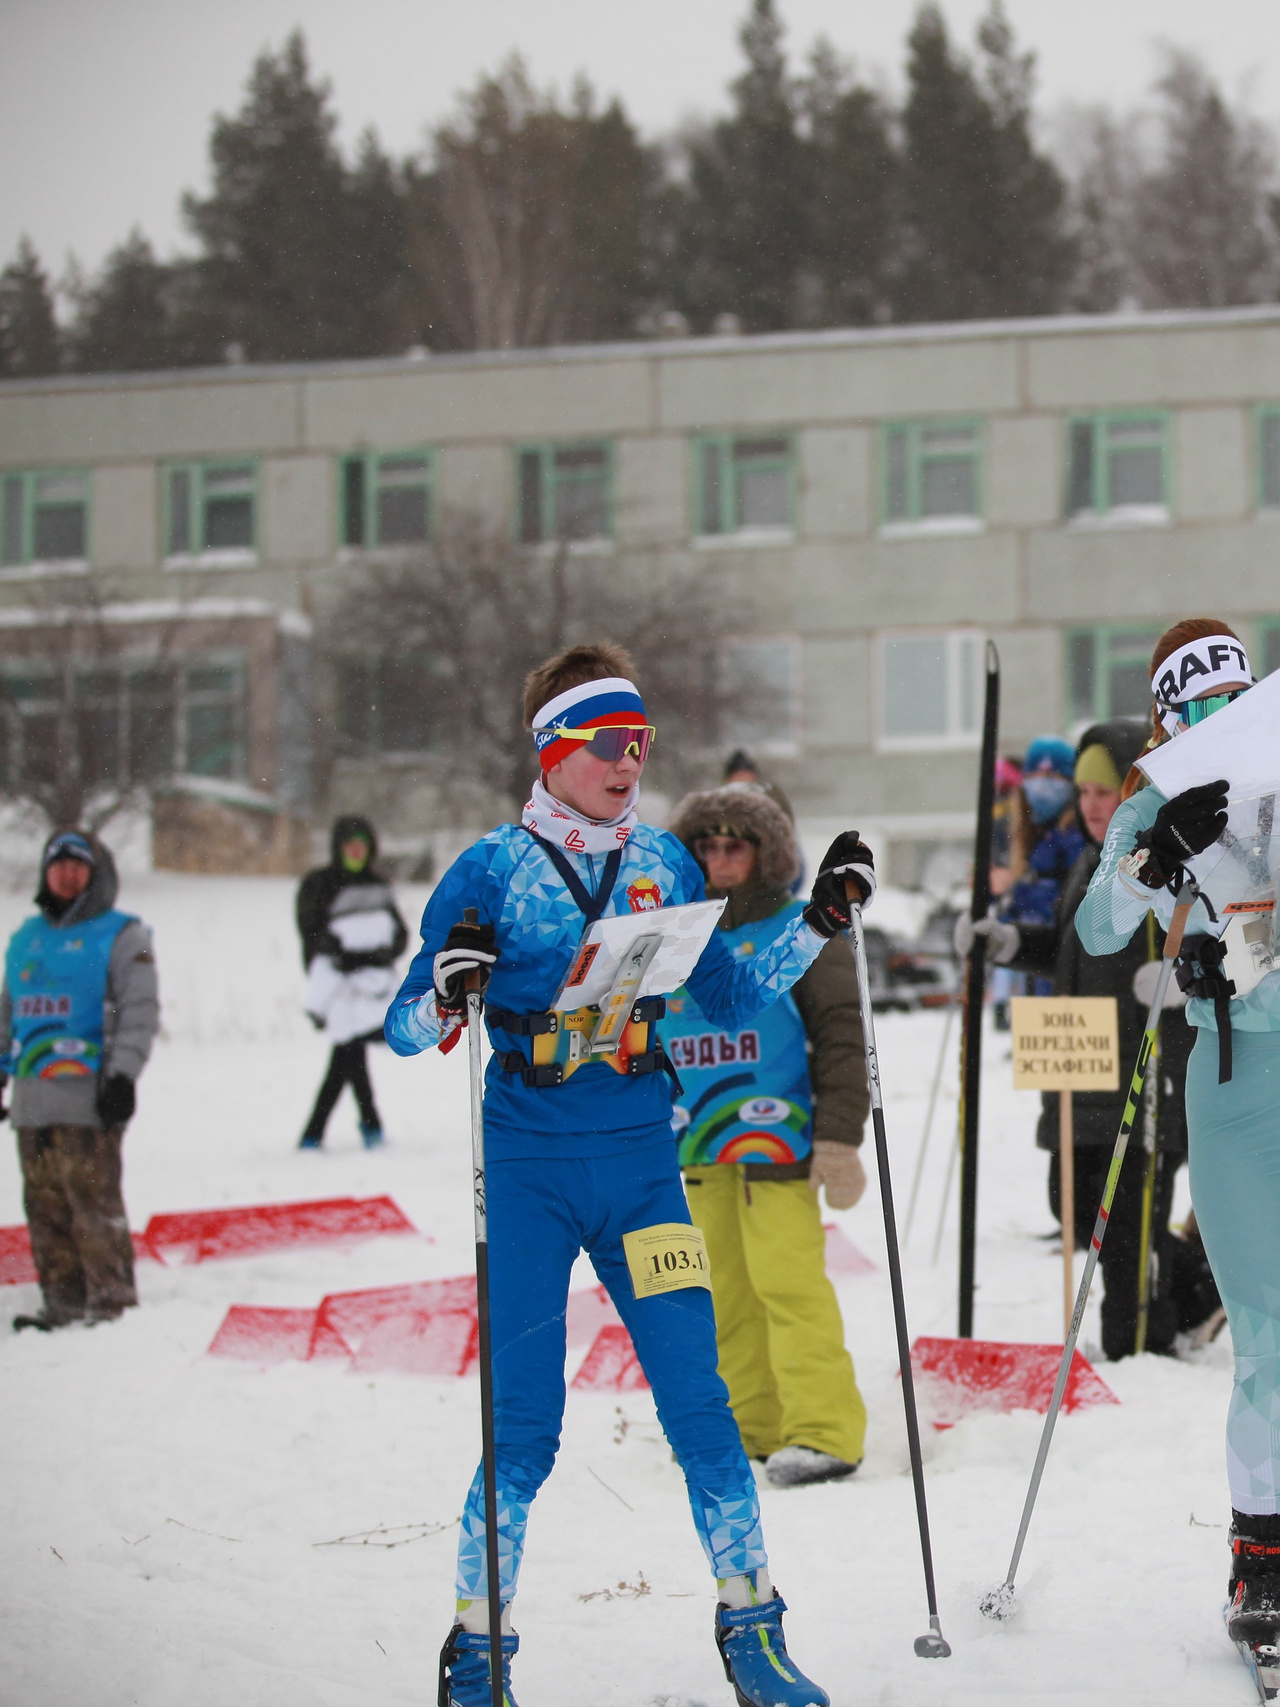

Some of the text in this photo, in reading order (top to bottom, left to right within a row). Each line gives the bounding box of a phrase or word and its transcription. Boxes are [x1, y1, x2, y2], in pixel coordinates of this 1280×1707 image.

[571, 945, 597, 985] booch
[1042, 1013, 1087, 1029] ЗОНА
[670, 1032, 758, 1068] СУДЬЯ
[1019, 1035, 1110, 1052] ПЕРЕДАЧИ
[1017, 1058, 1114, 1074] ЭСТАФЕТЫ
[650, 1249, 704, 1275] 103.1
[729, 1604, 777, 1622] SPINE
